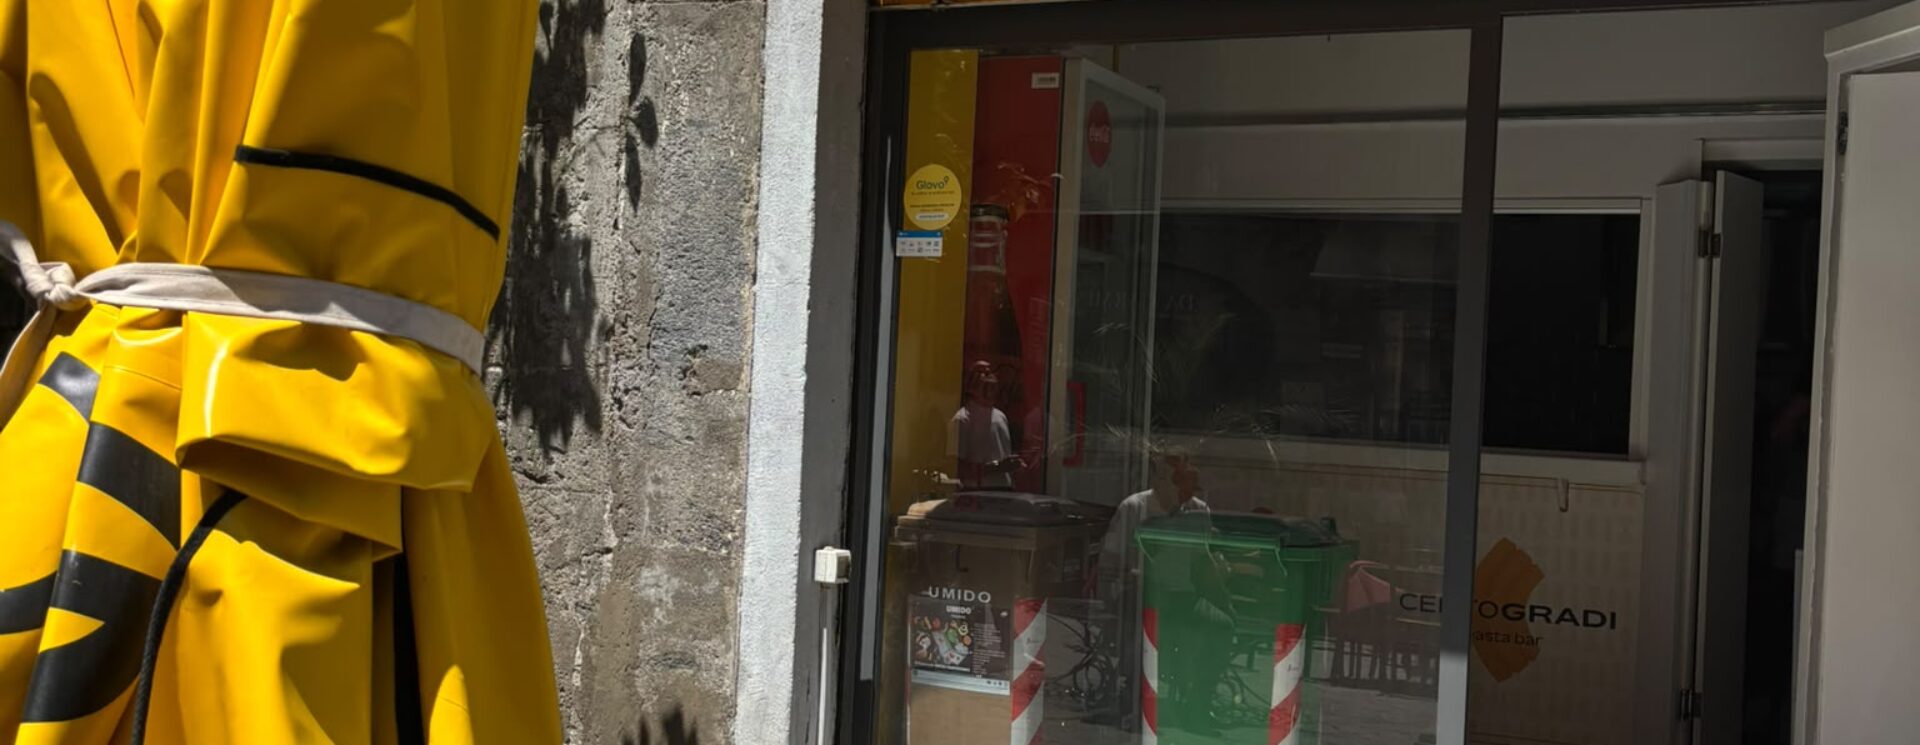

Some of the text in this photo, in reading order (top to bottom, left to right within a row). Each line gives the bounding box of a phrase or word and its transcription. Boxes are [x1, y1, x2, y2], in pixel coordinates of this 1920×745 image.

[916, 180, 946, 190] Glovo
[928, 586, 991, 604] UMIDO
[946, 605, 972, 615] UMIDO
[1400, 593, 1617, 630] CEOGRADI
[1514, 632, 1544, 647] bar
